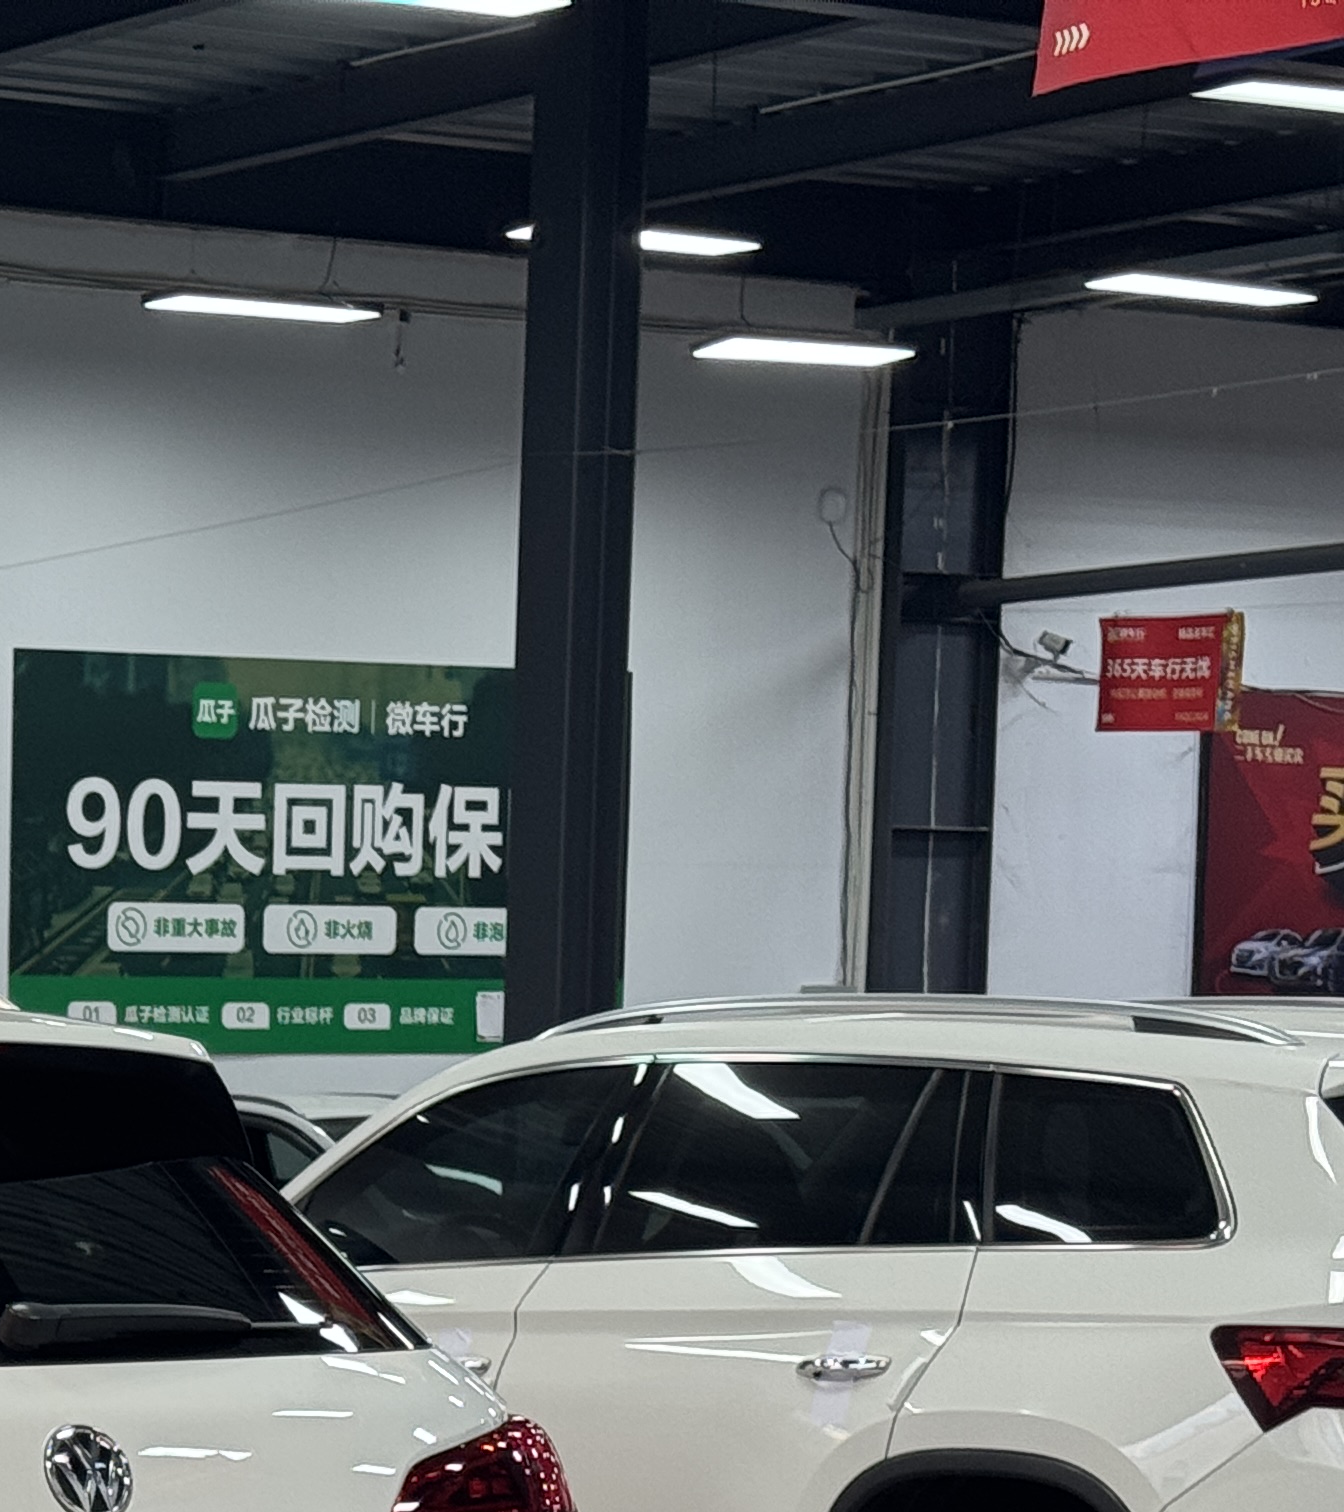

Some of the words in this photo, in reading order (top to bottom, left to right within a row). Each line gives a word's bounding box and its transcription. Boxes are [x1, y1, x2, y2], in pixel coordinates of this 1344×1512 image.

[196, 699, 237, 725] 瓜子
[249, 697, 360, 735] 瓜子检测
[385, 700, 469, 738] 微车行
[66, 776, 504, 879] 90天回购保
[153, 918, 238, 938] 非重大事故
[324, 920, 373, 941] 非火烧
[83, 1005, 100, 1022] 01
[236, 1008, 255, 1024] 02
[357, 1008, 376, 1024] 03
